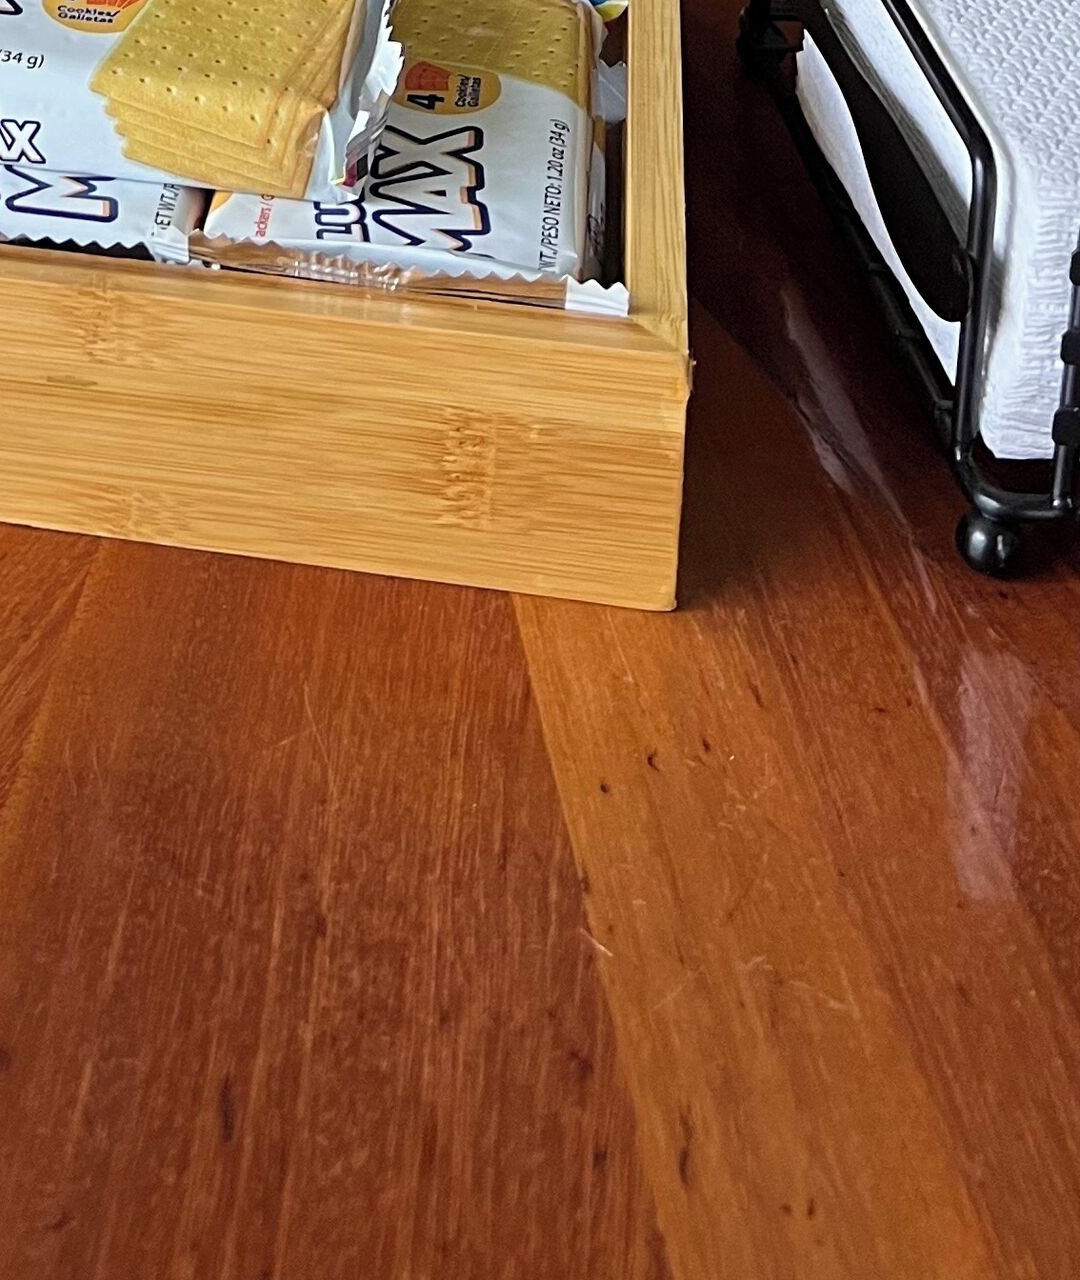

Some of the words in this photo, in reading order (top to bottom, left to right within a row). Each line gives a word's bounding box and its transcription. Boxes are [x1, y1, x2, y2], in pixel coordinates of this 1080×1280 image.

[58, 13, 114, 24] Galletas
[27, 53, 45, 70] g)
[406, 92, 445, 110] 4
[551, 147, 565, 160] oz
[547, 160, 564, 182] 1.20
[254, 206, 272, 238] ackers
